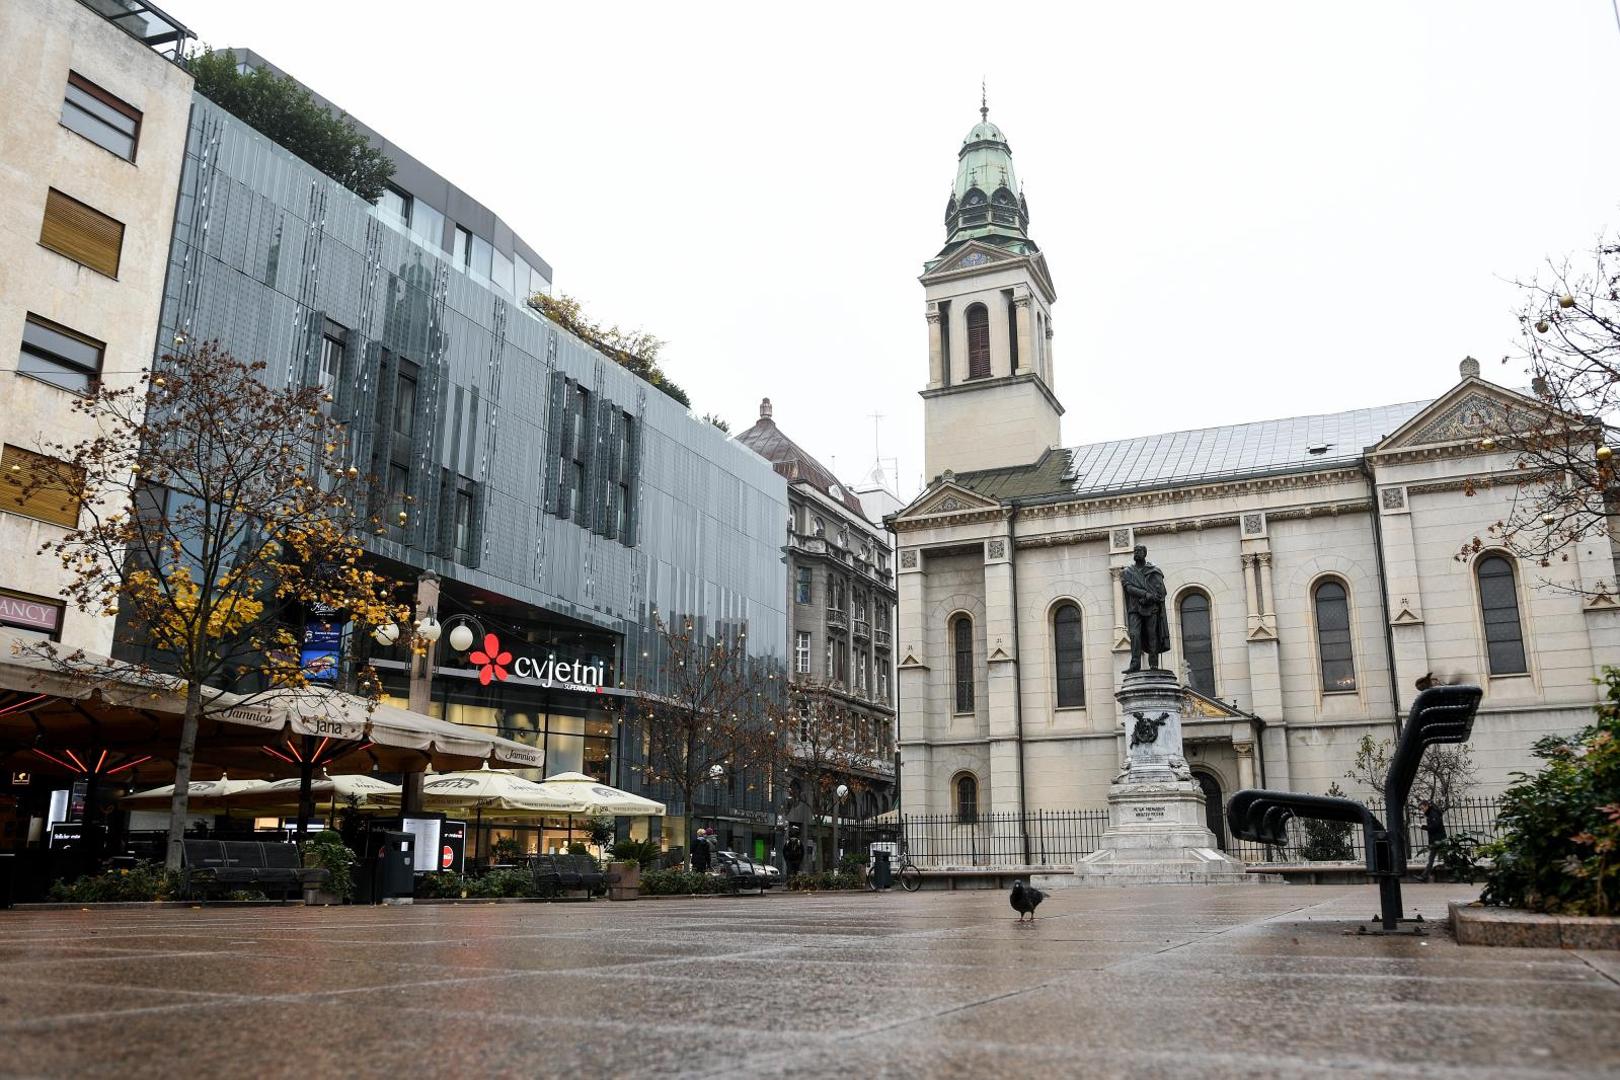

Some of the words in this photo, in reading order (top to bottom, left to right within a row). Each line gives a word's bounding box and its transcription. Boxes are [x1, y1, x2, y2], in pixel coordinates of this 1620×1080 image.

[514, 654, 604, 688] cvjetni
[221, 706, 273, 723] Jamnica
[505, 749, 536, 762] Jamnica
